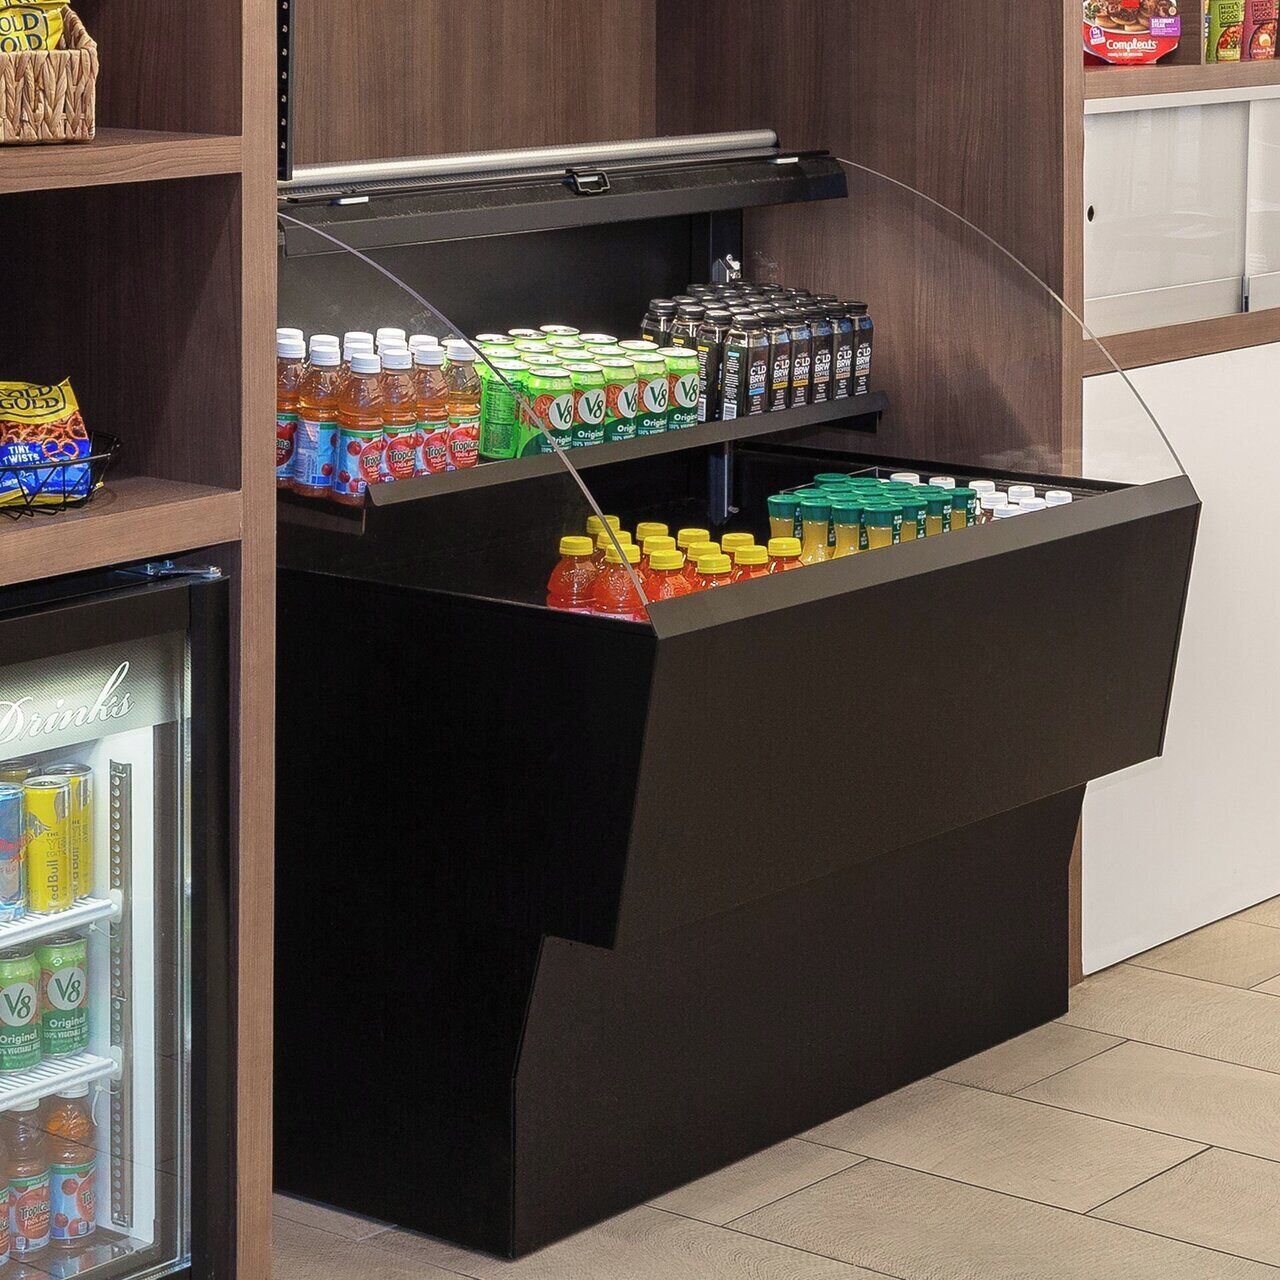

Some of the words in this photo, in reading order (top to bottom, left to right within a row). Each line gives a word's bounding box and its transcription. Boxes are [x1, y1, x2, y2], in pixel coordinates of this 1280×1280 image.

[1106, 37, 1157, 52] Compleats
[624, 387, 637, 412] V8
[650, 382, 667, 408] V8
[680, 377, 698, 403] V8
[556, 398, 572, 425] V8
[584, 393, 604, 419] V8
[3, 453, 39, 464] TWISTS
[8, 446, 30, 454] TINY
[55, 971, 81, 1003] V8
[4, 987, 31, 1019] V8
[49, 1012, 86, 1029] Original
[0, 1029, 37, 1045] Original
